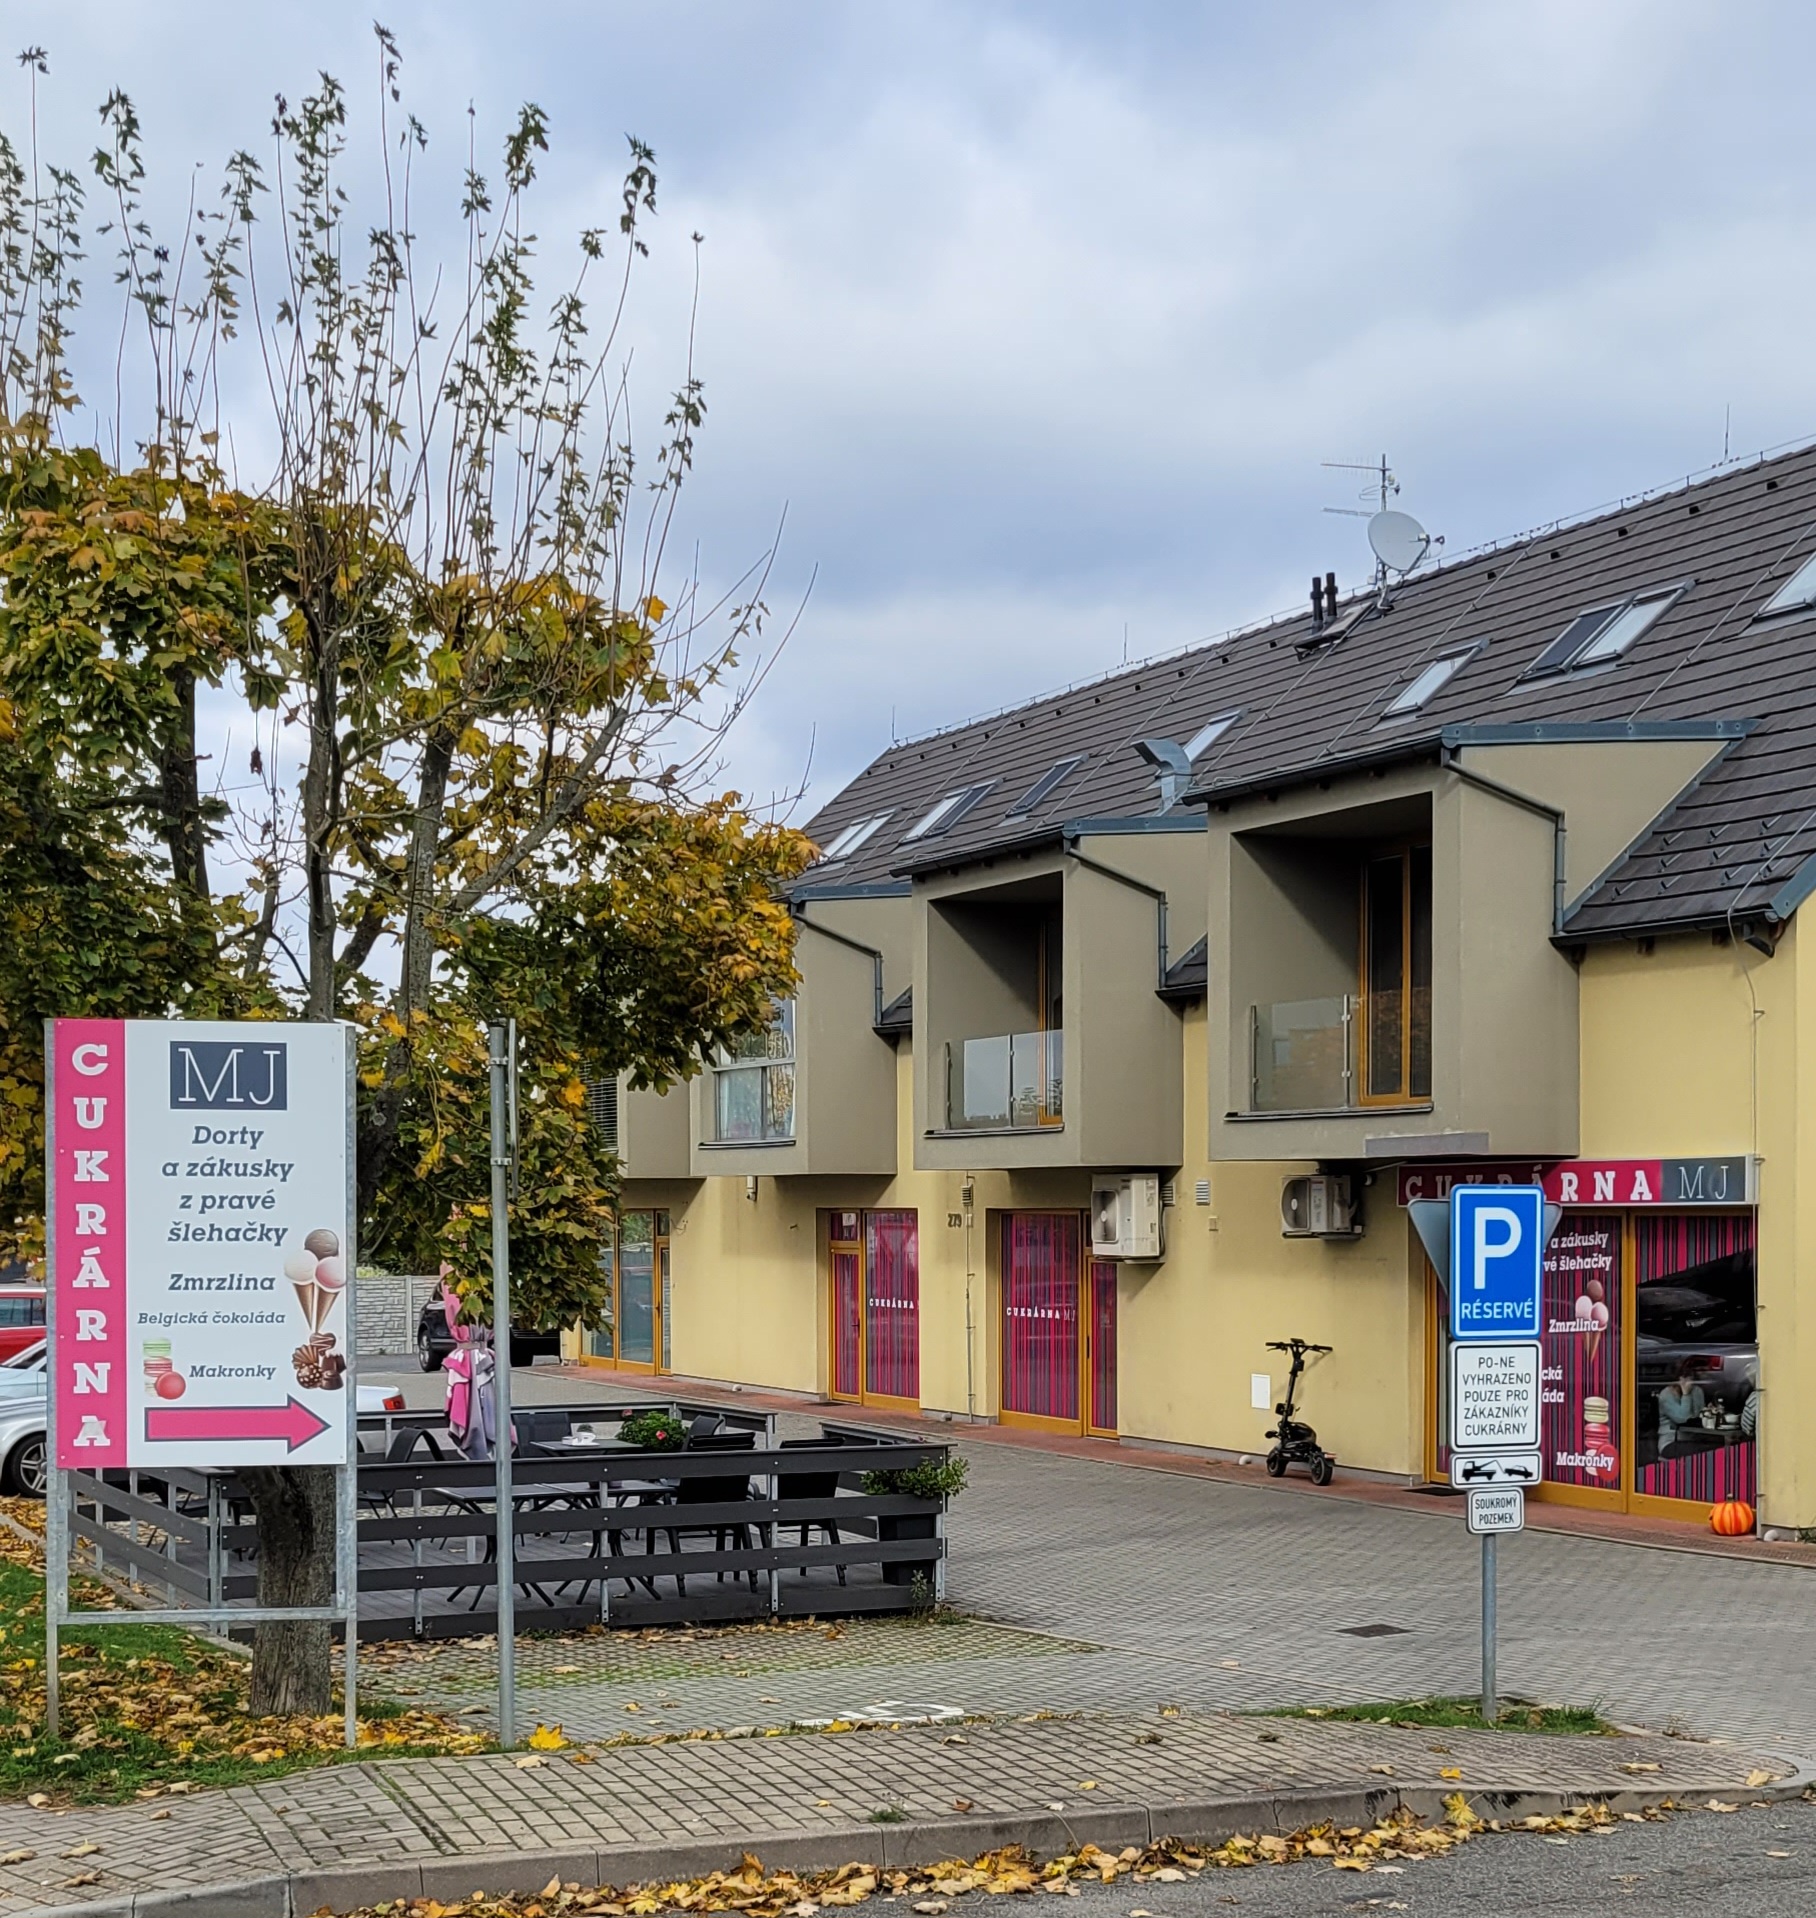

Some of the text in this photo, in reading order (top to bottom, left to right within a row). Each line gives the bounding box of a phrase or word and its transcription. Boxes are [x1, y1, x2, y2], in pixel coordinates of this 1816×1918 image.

[178, 1048, 281, 1105] MJ
[192, 1125, 264, 1150] Dorty
[161, 1156, 295, 1182] a zákusky
[1678, 1166, 1729, 1200] MJ
[179, 1189, 276, 1214] z pravé
[167, 1221, 288, 1247] šlehačky
[1551, 1231, 1609, 1249] a zákusky
[72, 1043, 111, 1447] CUKRÁRNA
[1474, 1207, 1522, 1290] P
[1559, 1253, 1613, 1272] šlehačky
[168, 1273, 276, 1291] Zmrzlina
[1461, 1298, 1533, 1319] RÉSERVÉ
[137, 1310, 286, 1327] Belgická čokoláda
[1549, 1318, 1600, 1333] Zmrzlina
[1478, 1356, 1516, 1369] PO-NE
[189, 1364, 277, 1380] Makronky
[1462, 1372, 1531, 1386] VYHRAZENO
[1464, 1389, 1529, 1402] POUZE PRO
[1463, 1403, 1529, 1419] ZÁKAZNÍKY
[1464, 1421, 1527, 1436] CUKRÁRNY
[1556, 1452, 1614, 1471] Makronky
[1479, 1512, 1514, 1525] POZEMEK
